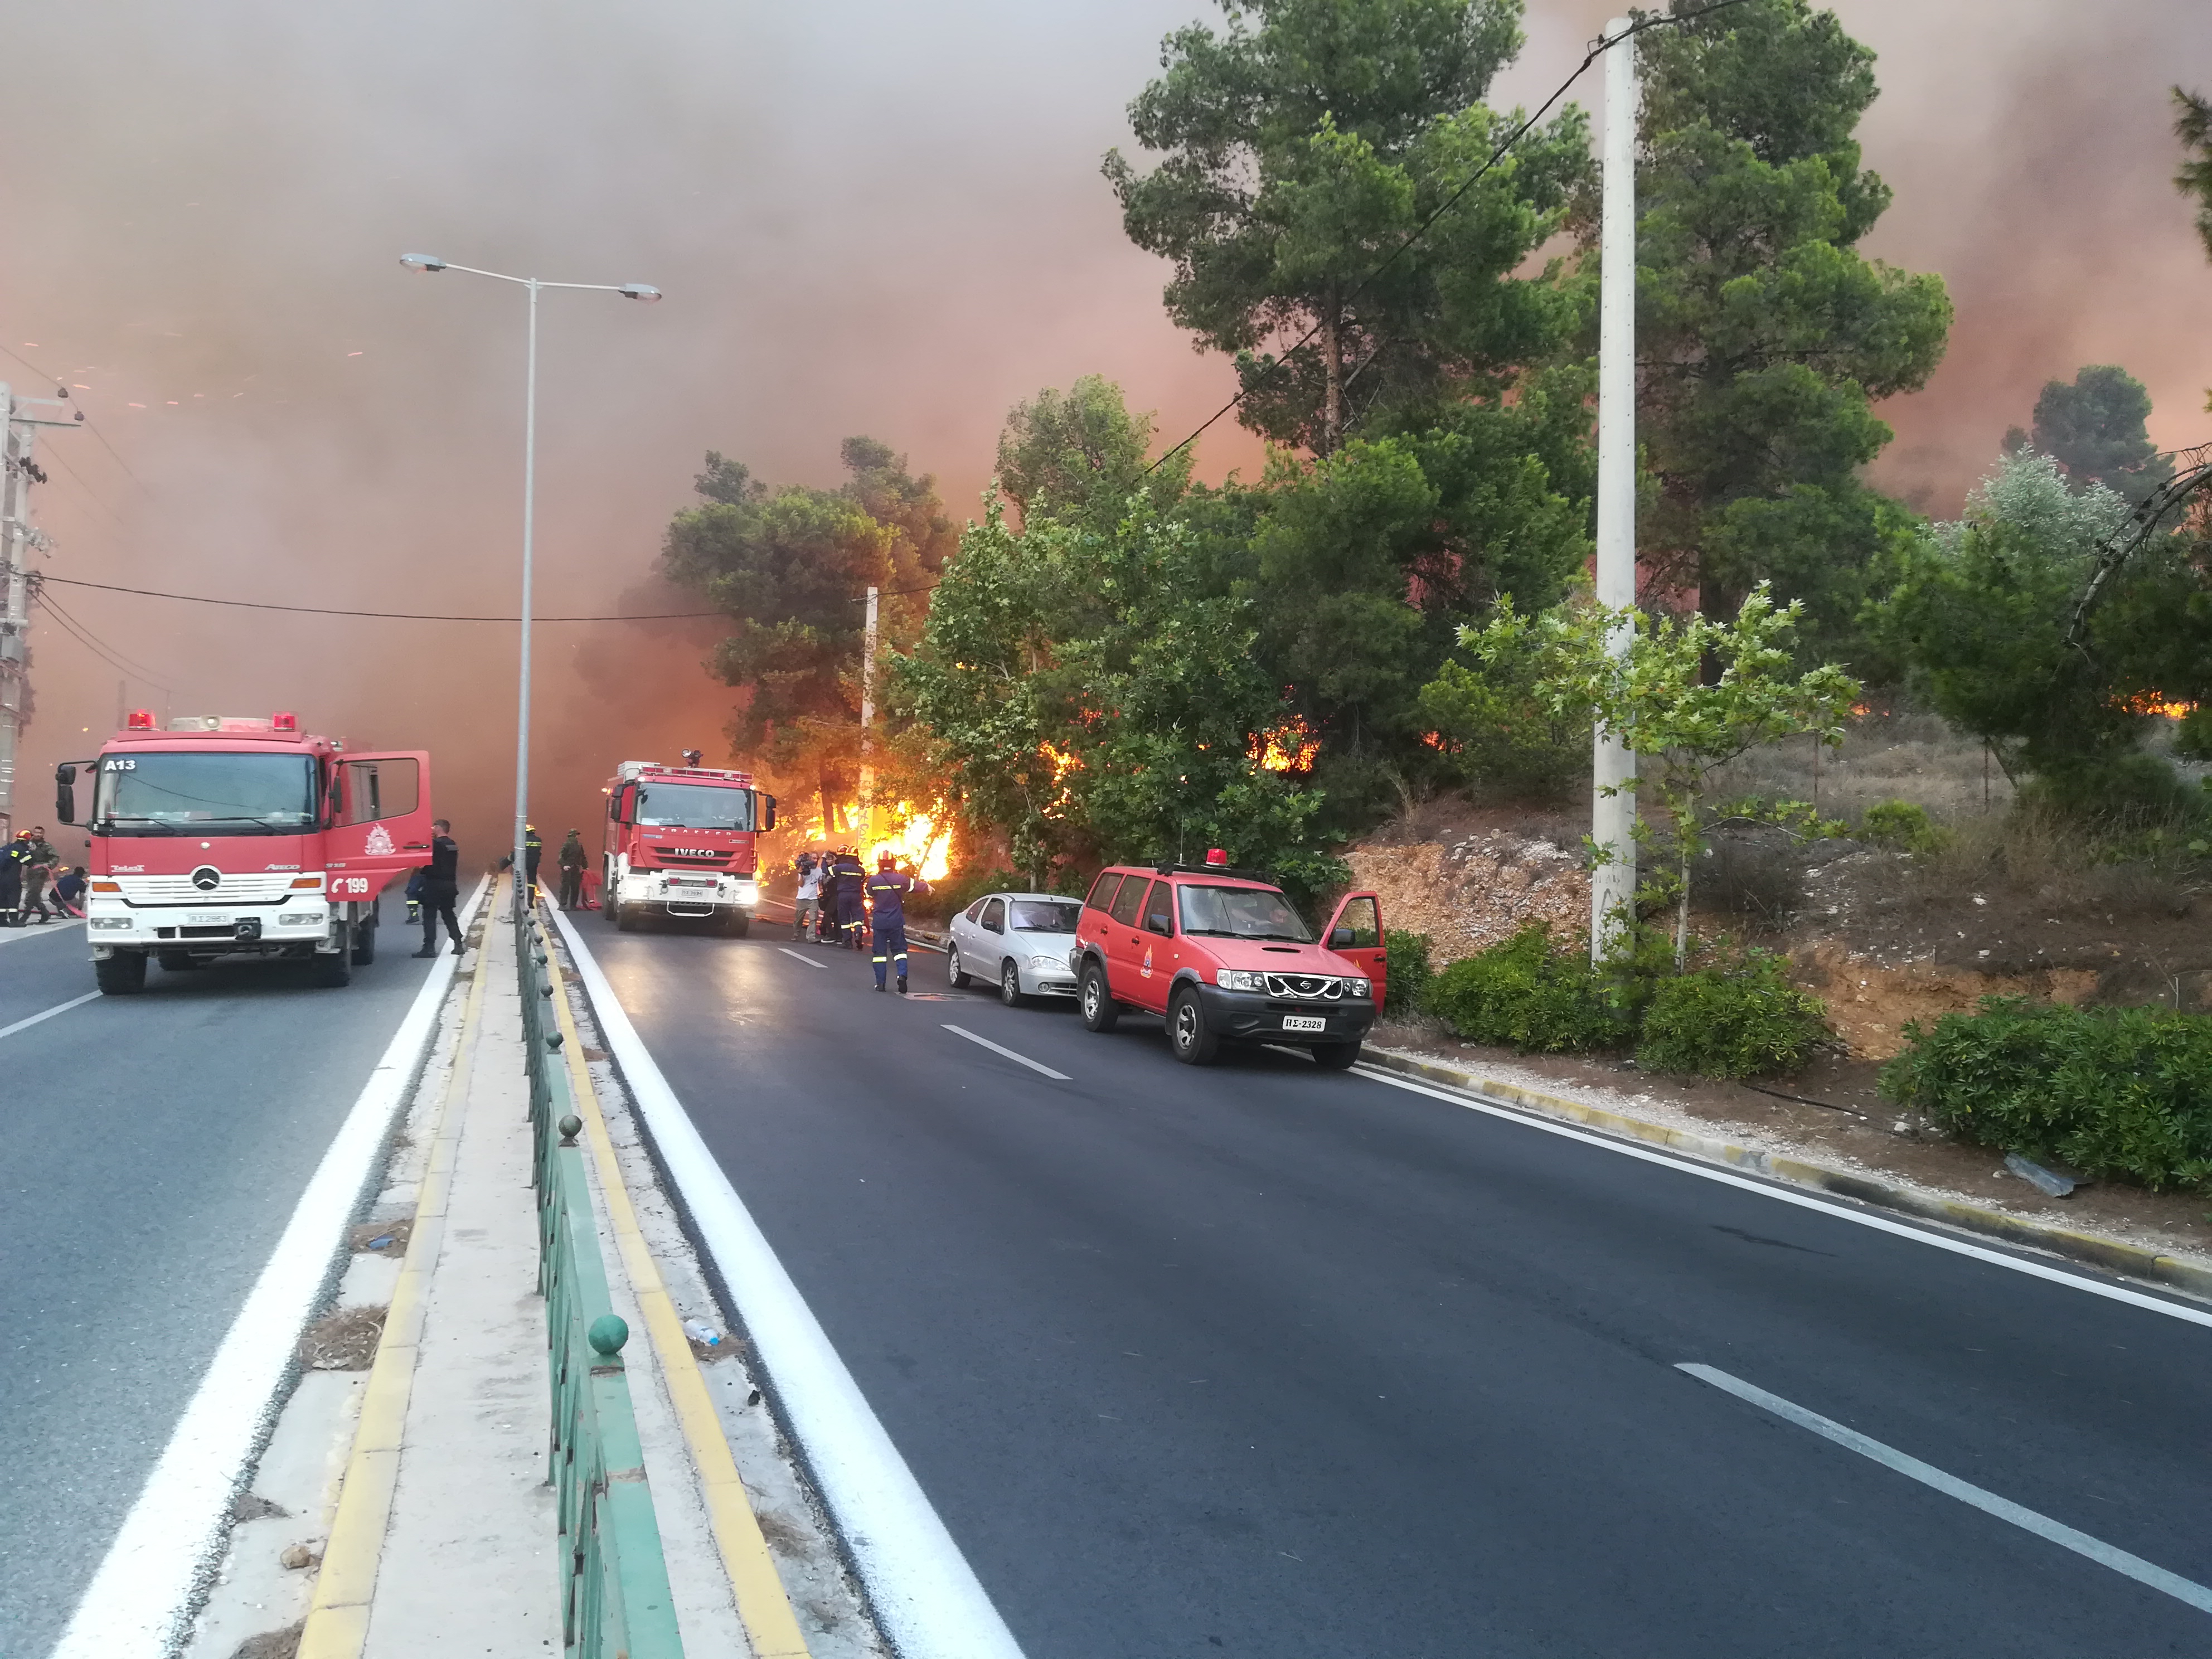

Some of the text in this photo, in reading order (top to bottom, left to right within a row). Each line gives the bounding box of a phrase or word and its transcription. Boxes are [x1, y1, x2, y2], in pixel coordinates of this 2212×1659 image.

[105, 760, 135, 770] A13
[675, 848, 714, 858] IVECO
[345, 877, 368, 893] 199
[1286, 1019, 1322, 1029] ΠΣ-2328
